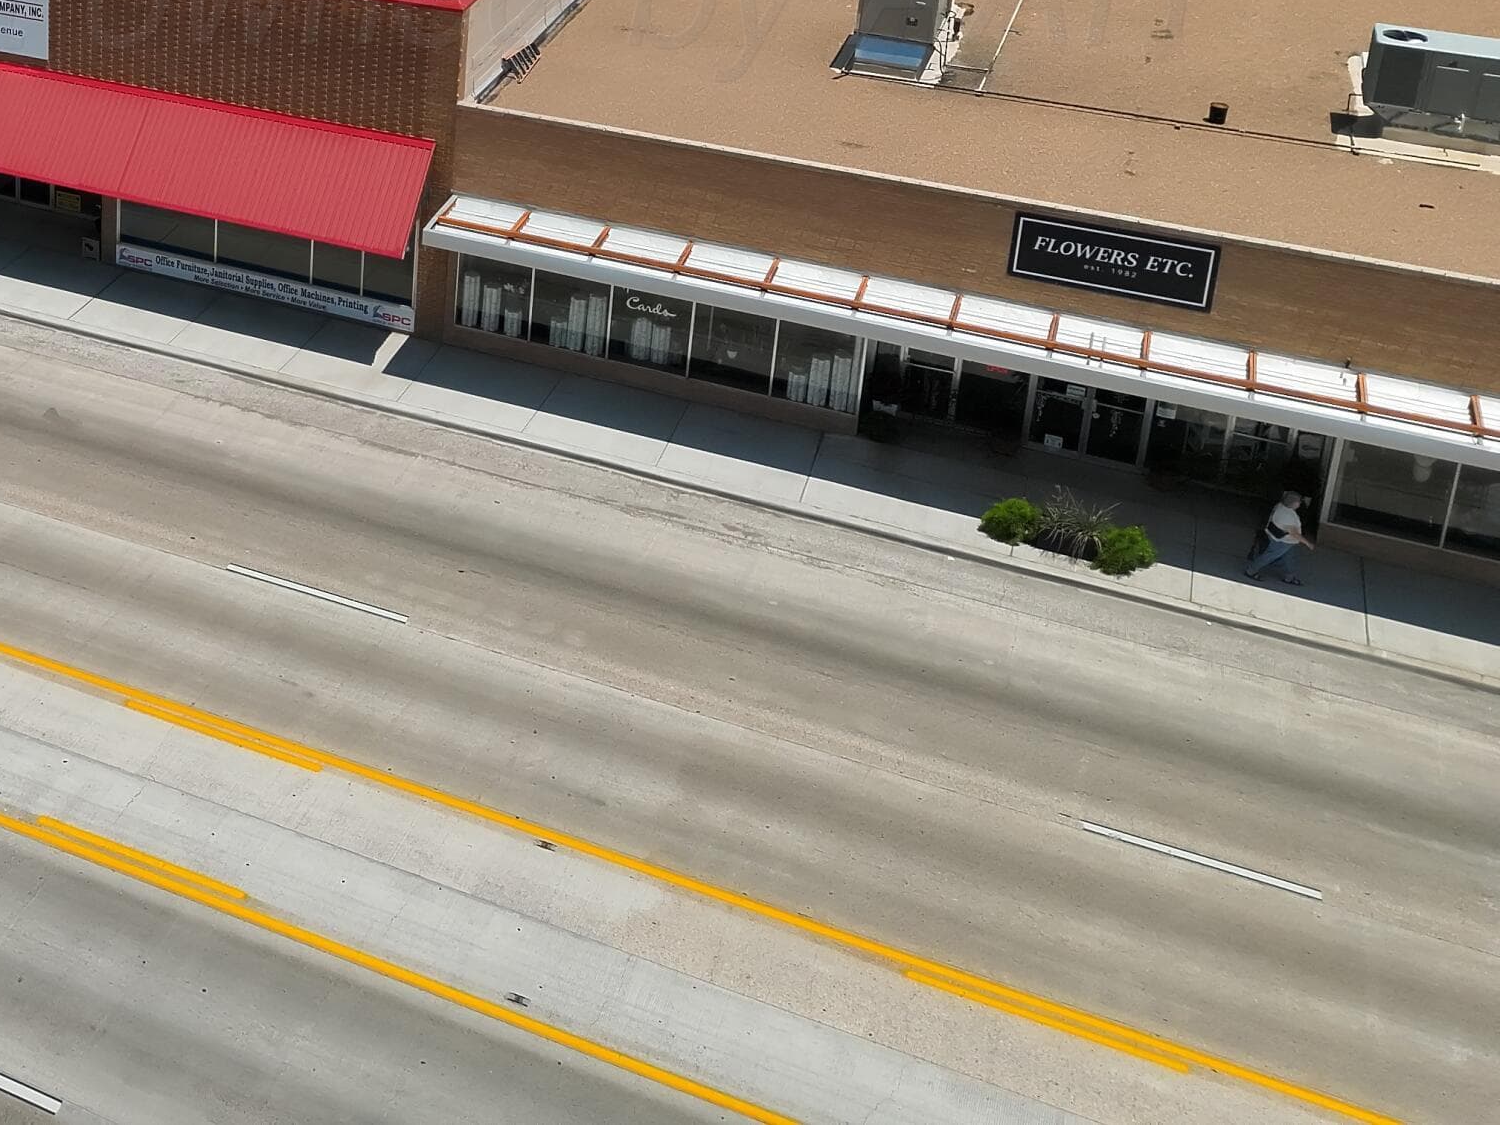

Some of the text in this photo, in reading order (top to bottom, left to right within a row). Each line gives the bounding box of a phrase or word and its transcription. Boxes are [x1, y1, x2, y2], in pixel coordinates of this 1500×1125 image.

[29, 6, 44, 19] INC.
[128, 255, 153, 267] SPC
[1034, 236, 1194, 278] FLOWERS ETC.
[155, 255, 175, 268] Office
[176, 259, 210, 277] Furniture,
[210, 267, 244, 285] Janitorial
[245, 275, 277, 292] Supplies,
[278, 283, 299, 296] Office
[300, 287, 337, 306] Machines,
[338, 296, 369, 315] Printing
[626, 296, 677, 317] Cards
[381, 312, 411, 326] SPC
